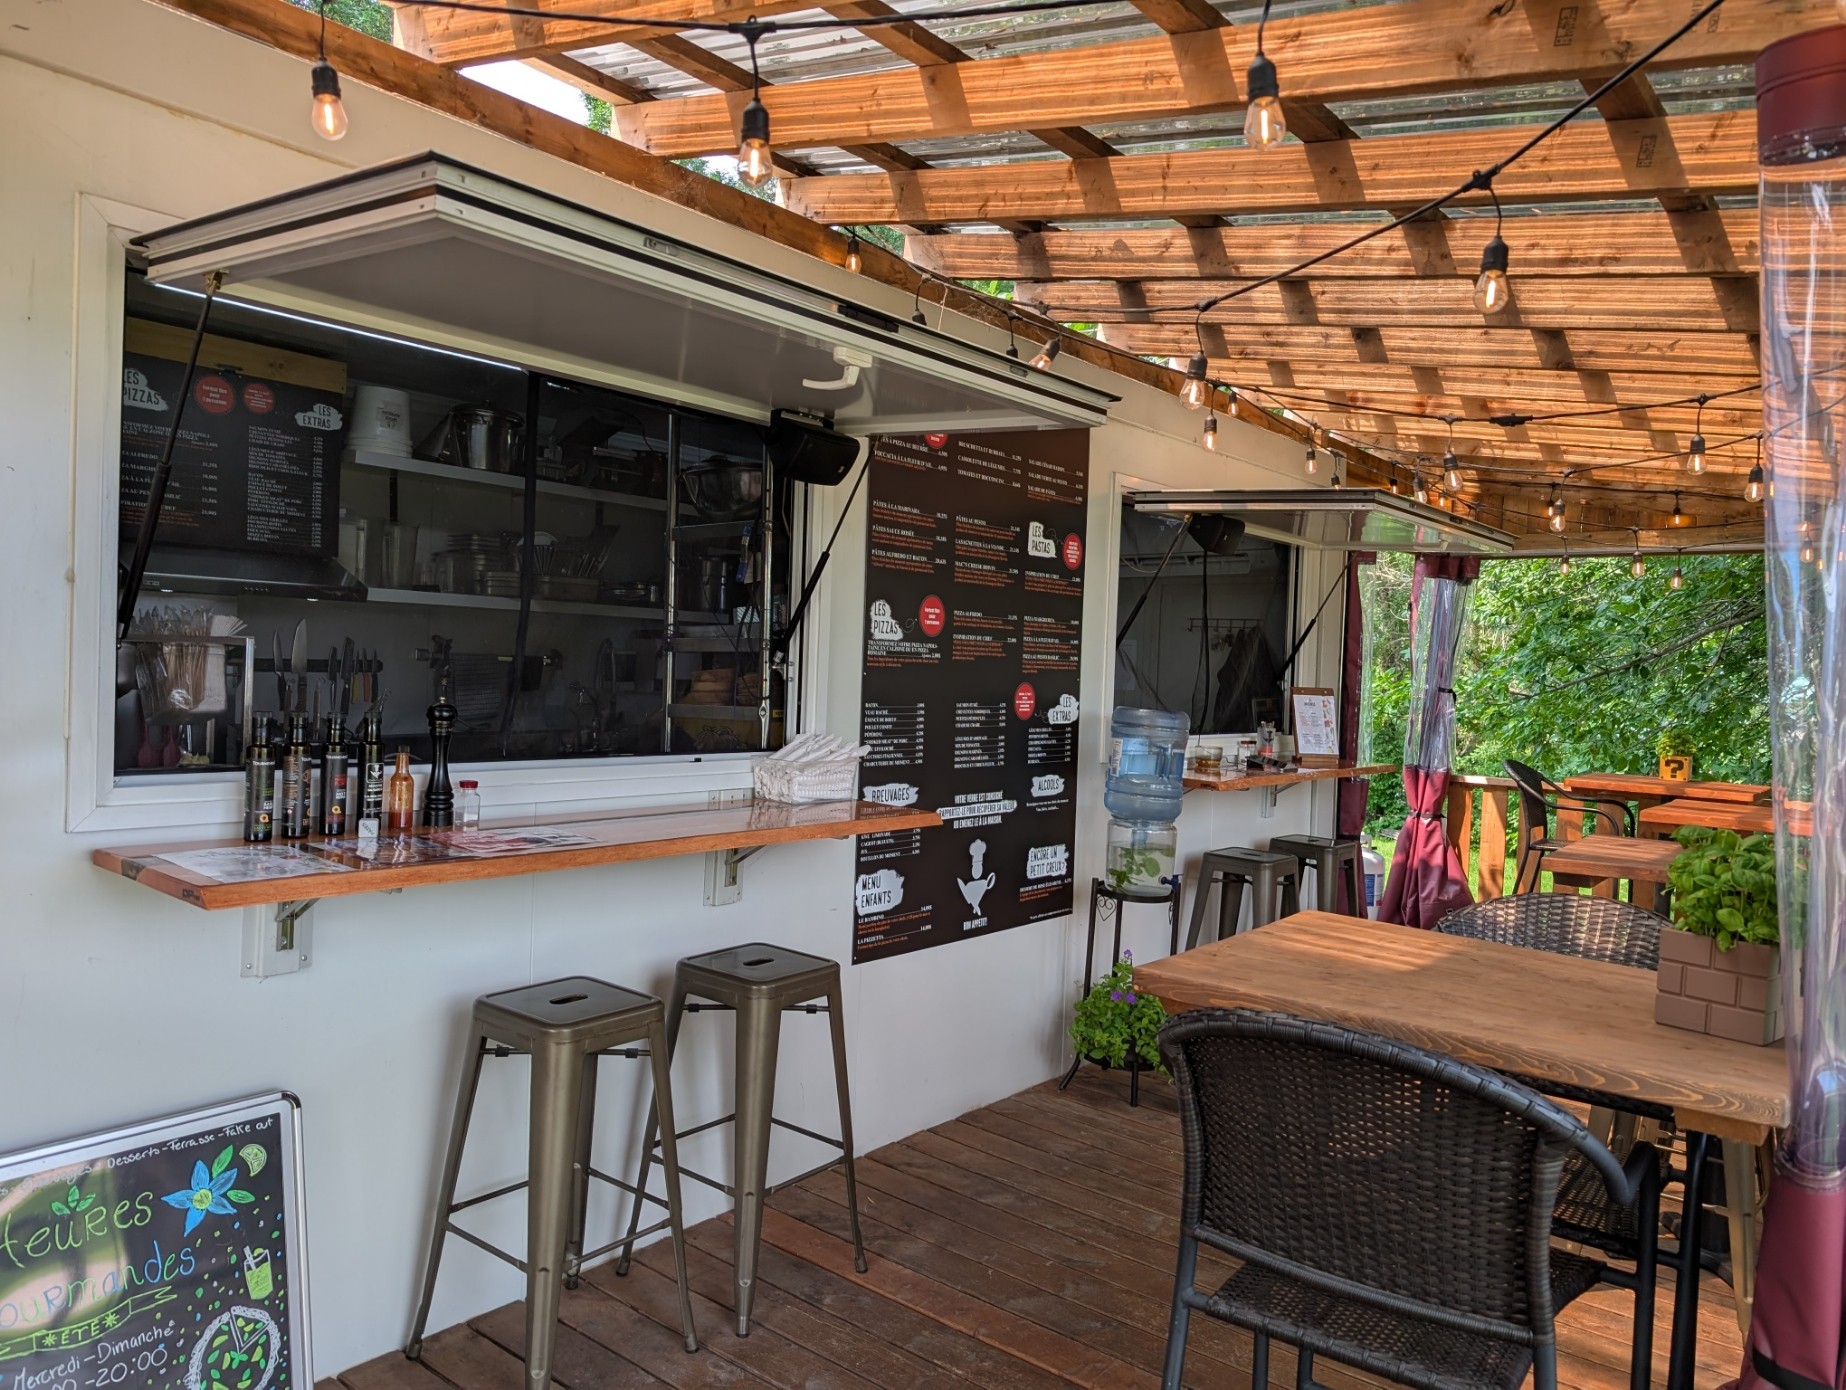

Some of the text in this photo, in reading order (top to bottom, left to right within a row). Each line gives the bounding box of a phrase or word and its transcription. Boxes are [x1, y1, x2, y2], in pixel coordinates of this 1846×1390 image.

[124, 371, 139, 385] ES
[319, 405, 331, 416] LES
[303, 415, 331, 428] EXTRAS
[1032, 525, 1041, 537] LES
[1032, 540, 1050, 554] PASTAS
[874, 602, 886, 617] LES
[874, 620, 898, 634] PIZZAS
[1063, 697, 1072, 708] LES
[1053, 711, 1071, 721] EXTRAS
[1038, 779, 1059, 791] ALCOOLS
[872, 788, 910, 802] BREUVAGES
[1031, 847, 1058, 862] ENCORE UN
[1030, 864, 1045, 877] PETIT
[862, 875, 880, 891] MENU
[861, 890, 891, 908] ENFANTS
[13, 1326, 173, 1390] Mercredi Dimanche
